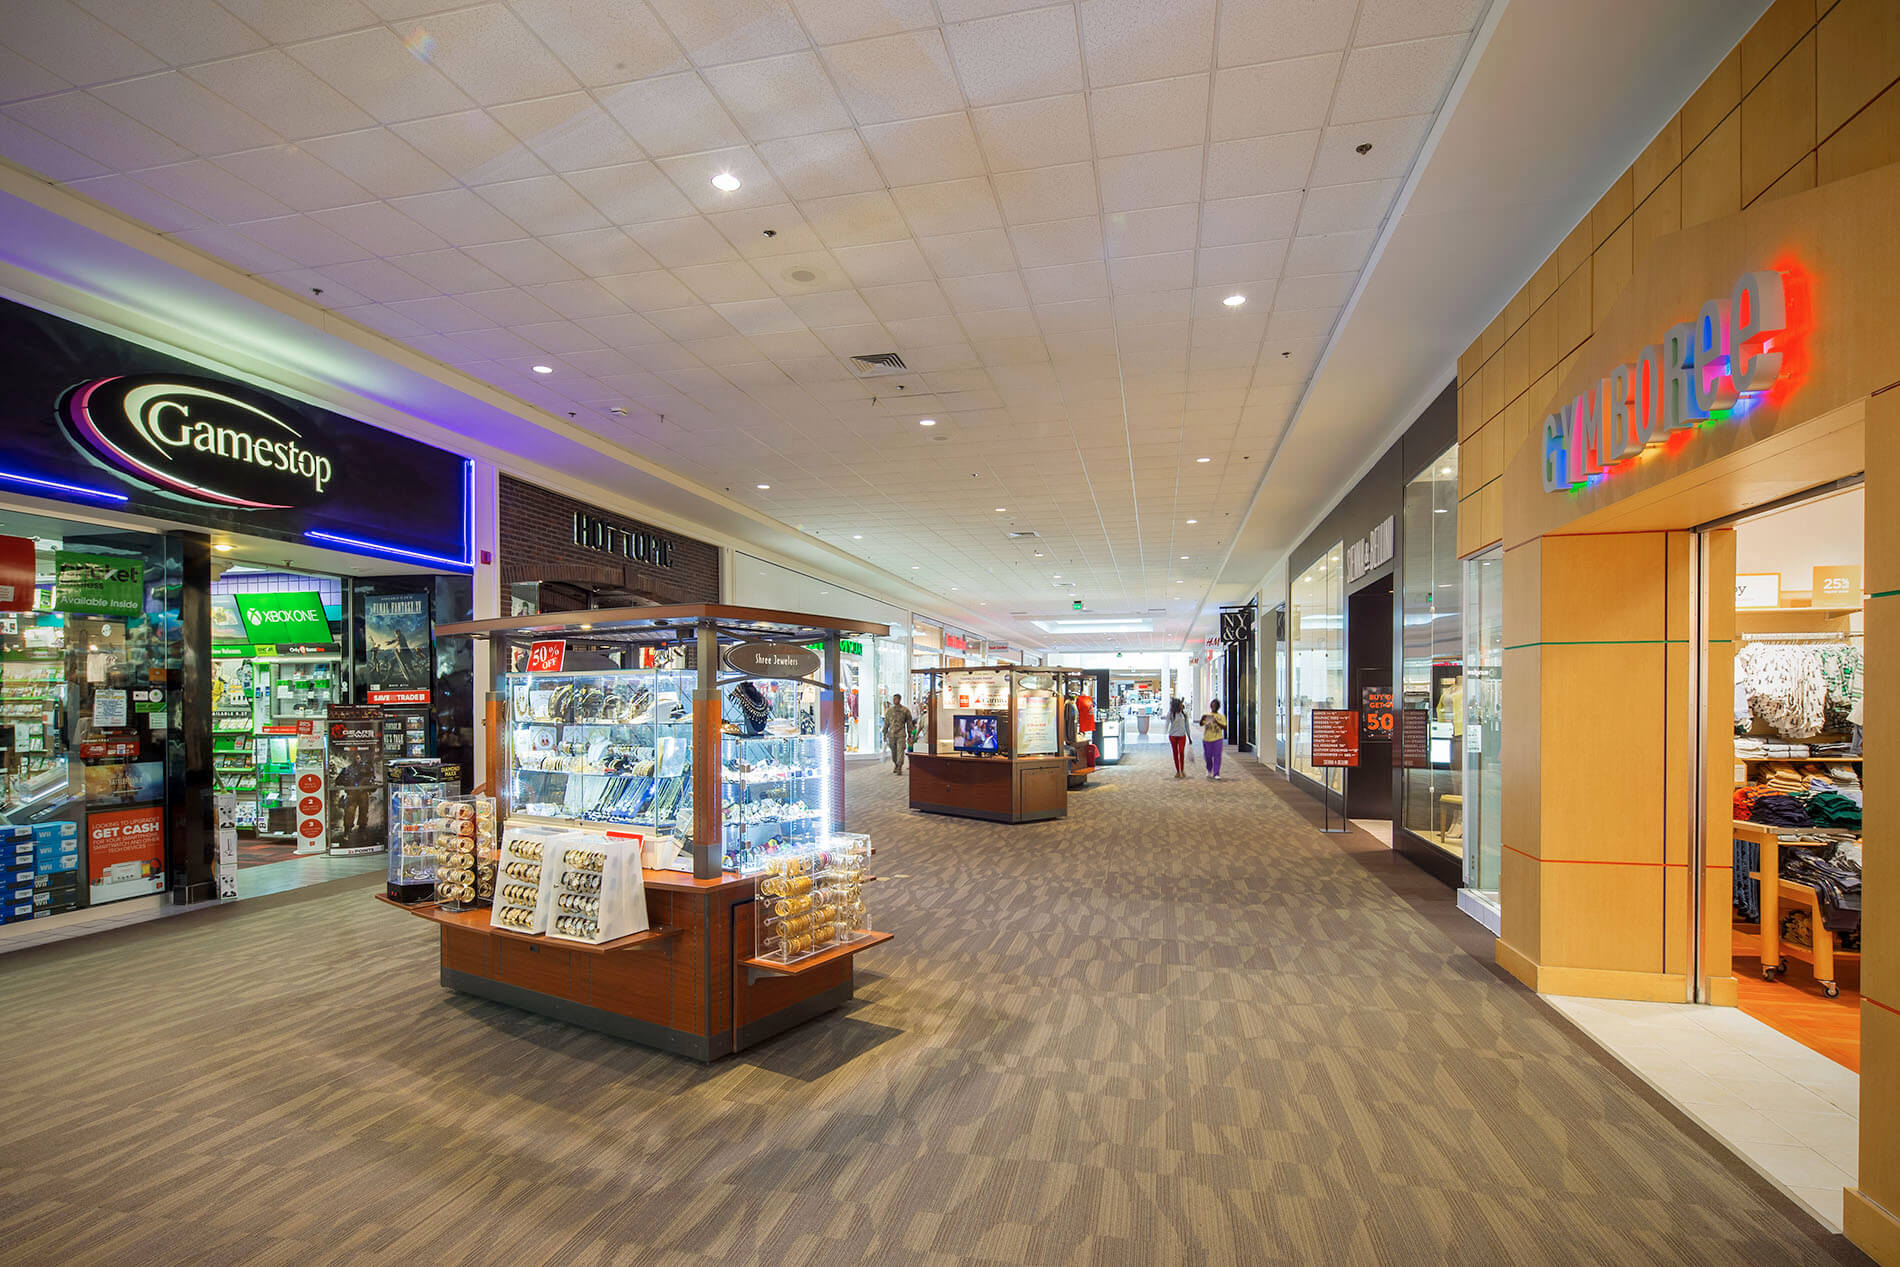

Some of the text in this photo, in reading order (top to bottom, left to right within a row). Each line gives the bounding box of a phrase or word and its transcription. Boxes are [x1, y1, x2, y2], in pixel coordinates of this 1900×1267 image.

[148, 400, 332, 493] Gamestop
[573, 511, 675, 568] HOT TOPIC
[60, 595, 138, 609] Available Inside
[262, 609, 319, 623] XBOX ONE
[1223, 614, 1248, 627] NY
[542, 656, 557, 670] OFF
[755, 653, 798, 666] Shree Jewelers
[1367, 713, 1394, 731] 50
[92, 822, 159, 839] GET CASH
